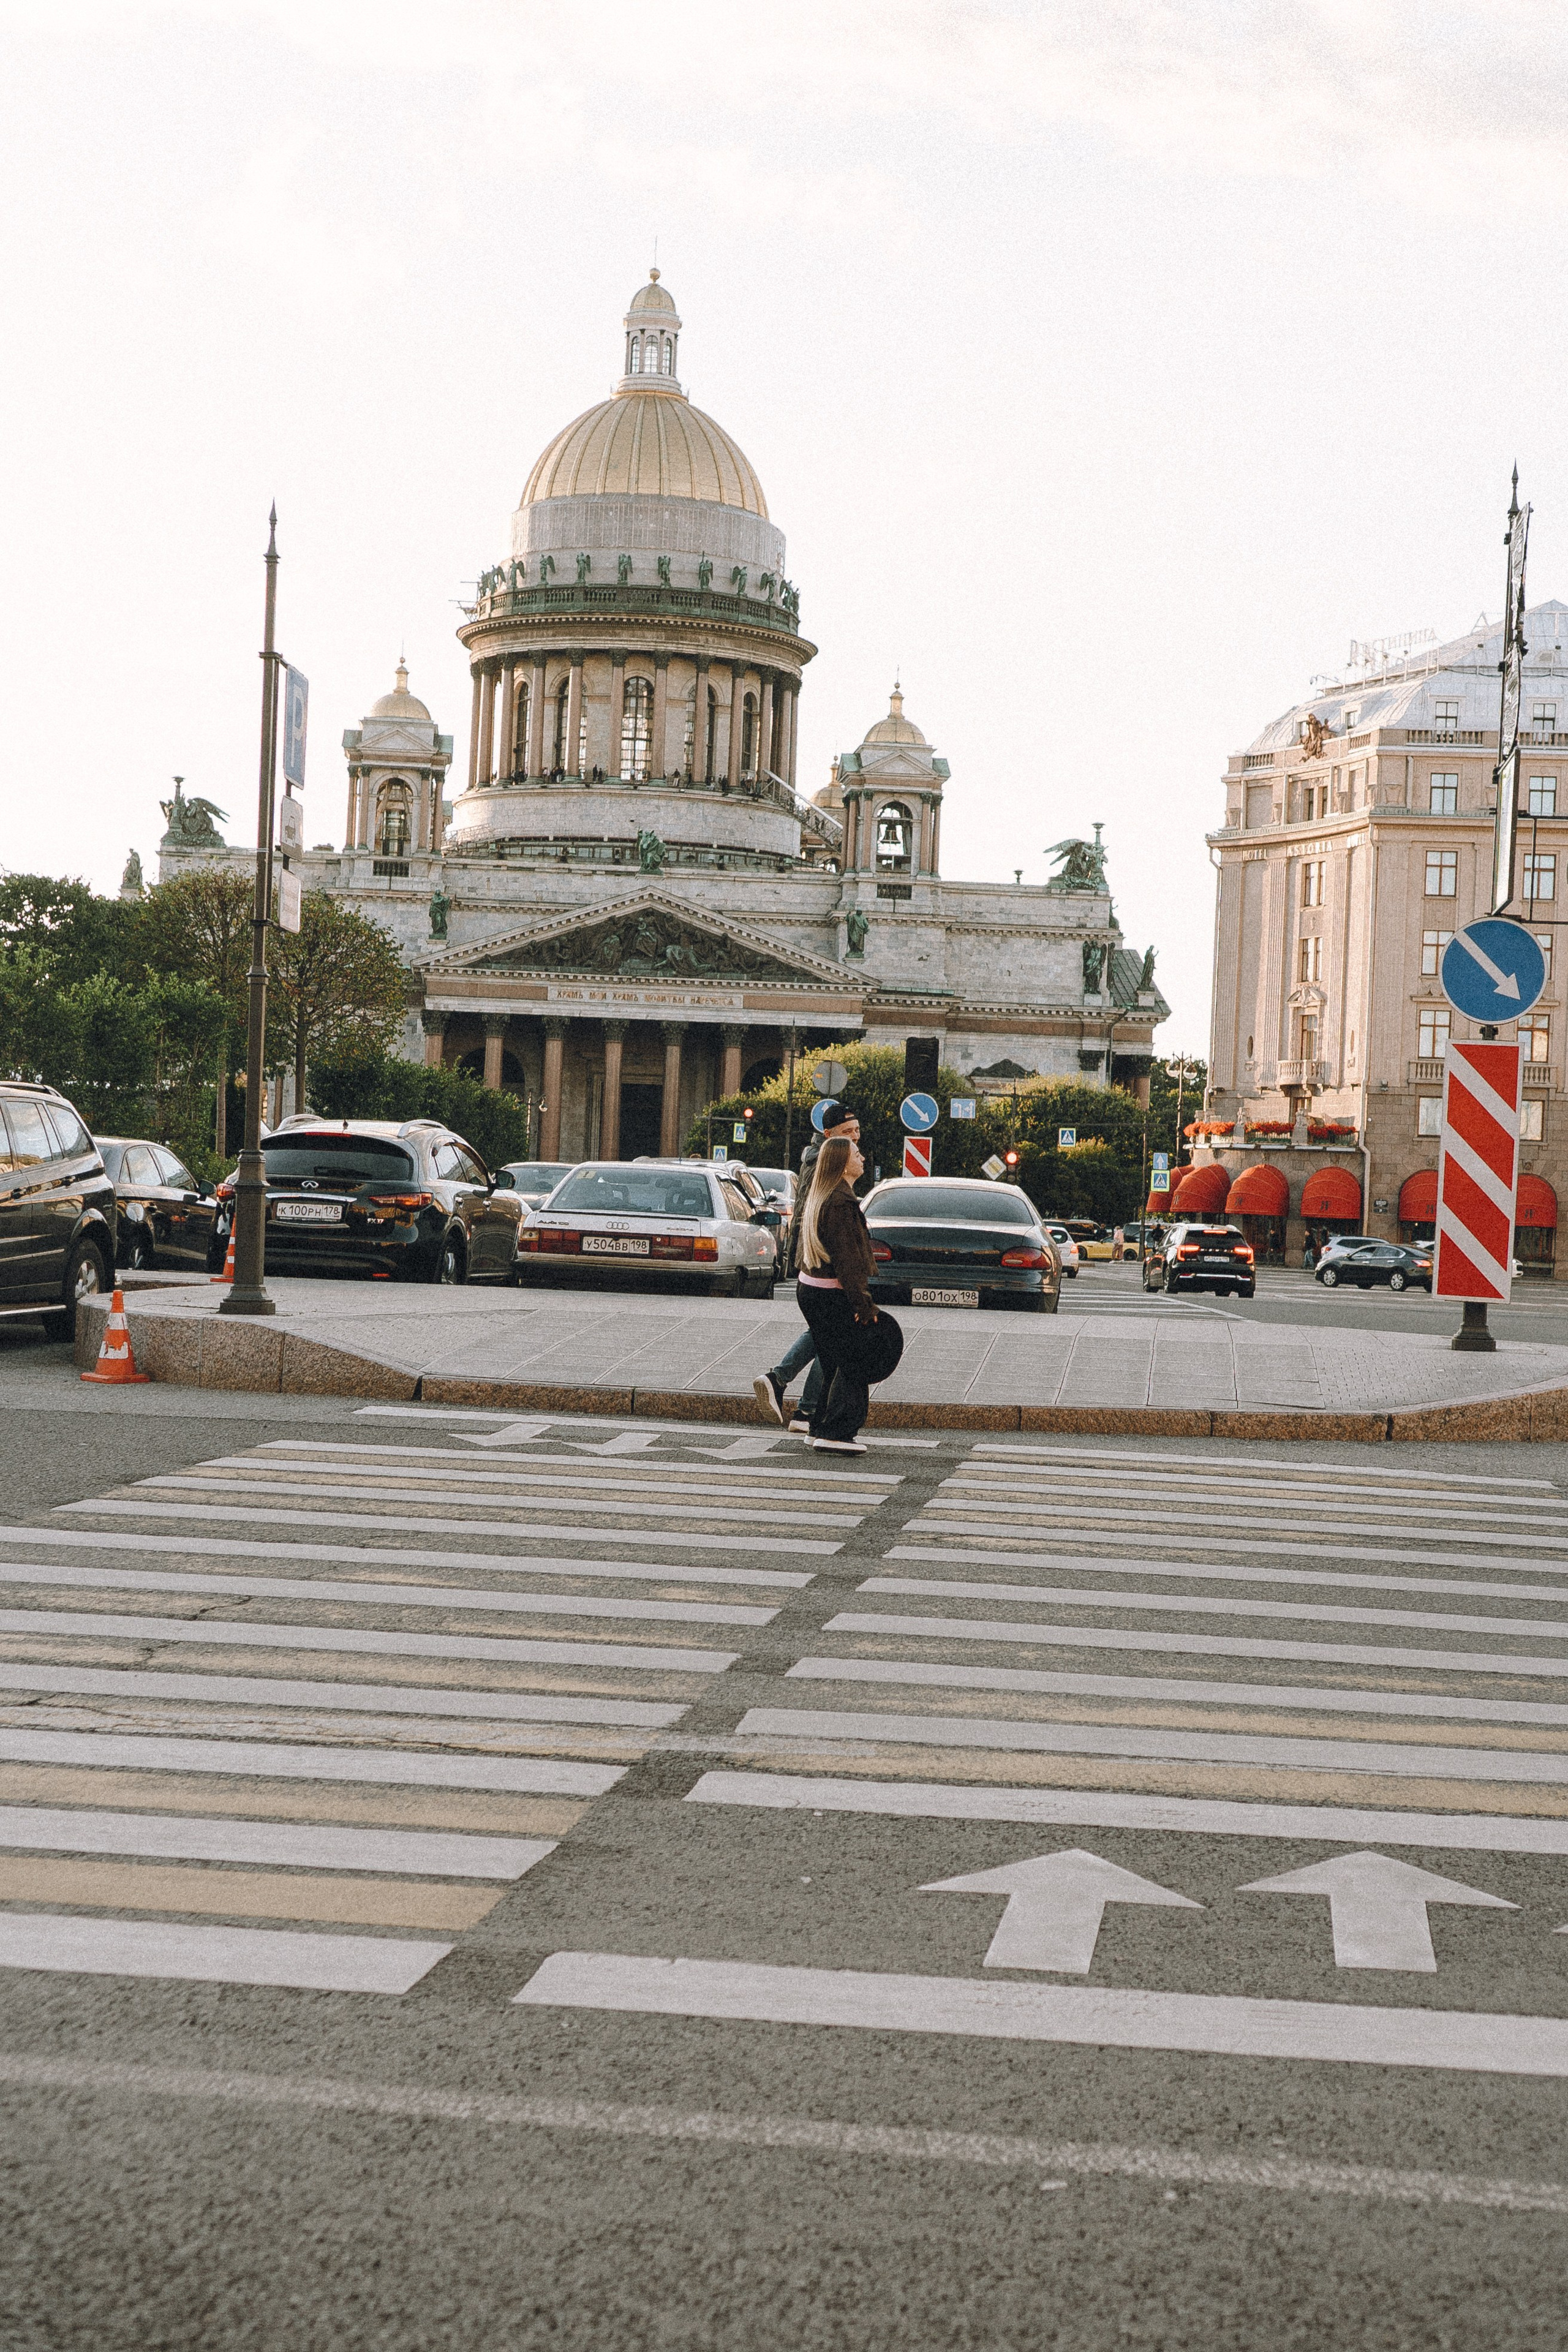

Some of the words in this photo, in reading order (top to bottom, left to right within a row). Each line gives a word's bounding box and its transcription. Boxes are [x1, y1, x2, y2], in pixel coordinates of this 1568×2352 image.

[291, 684, 305, 767] P
[1242, 849, 1268, 861] HOTEL
[1287, 840, 1333, 857] ASTORIA
[557, 990, 583, 999] ХРАМЪ
[612, 992, 638, 1001] ХРАМЪ
[323, 1206, 339, 1215] 178
[631, 1240, 647, 1249] 198
[960, 1291, 976, 1300] 198
